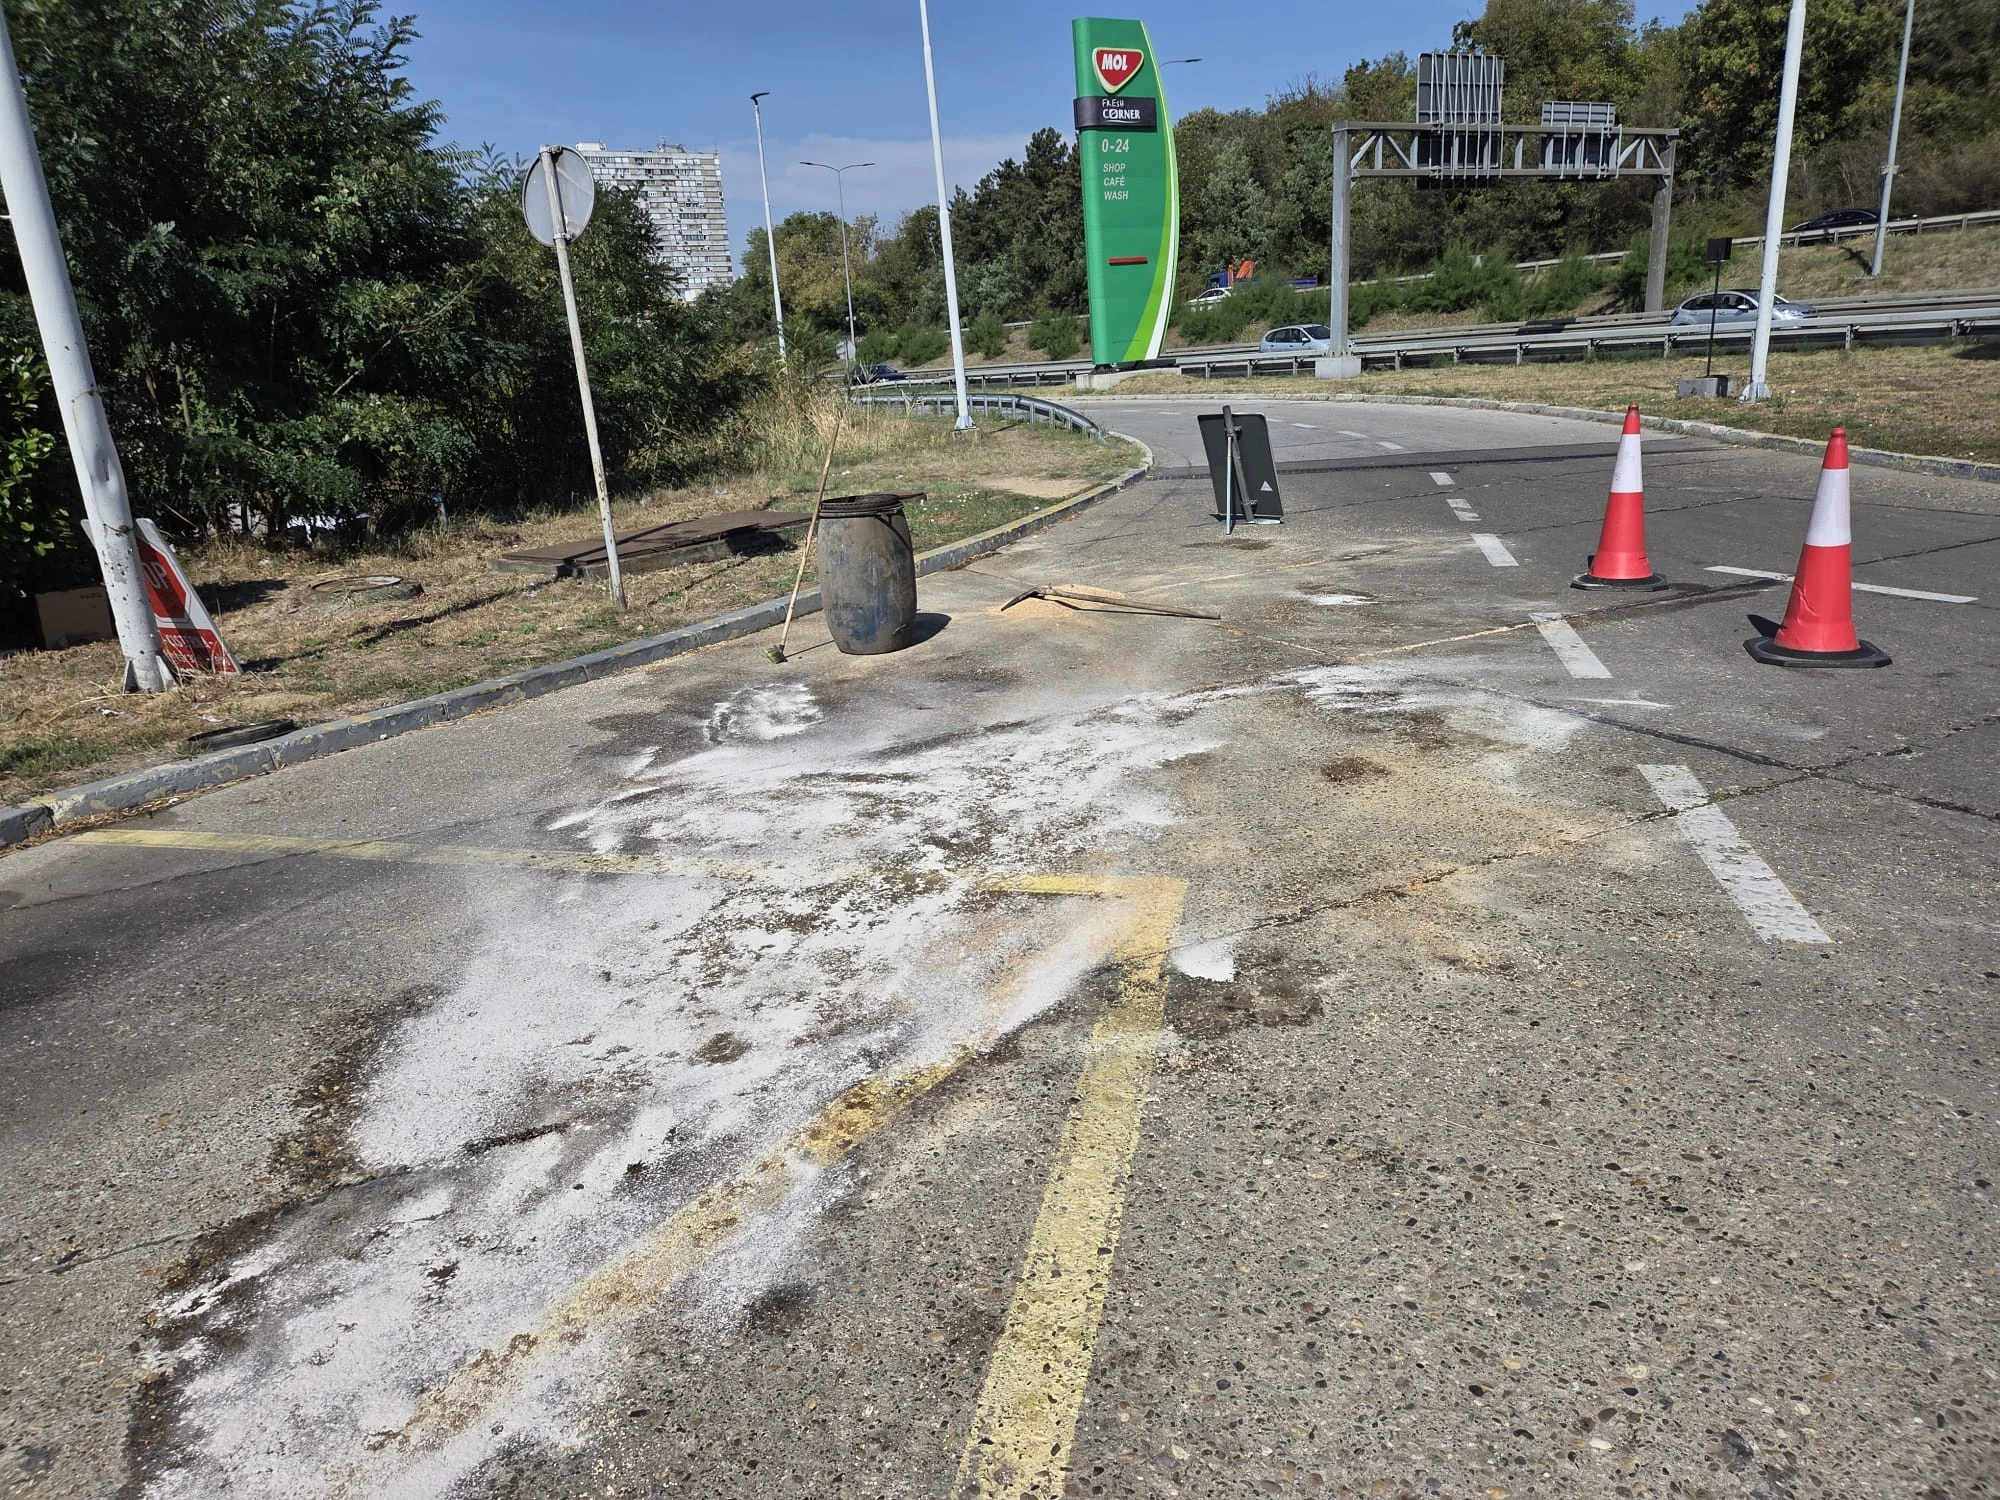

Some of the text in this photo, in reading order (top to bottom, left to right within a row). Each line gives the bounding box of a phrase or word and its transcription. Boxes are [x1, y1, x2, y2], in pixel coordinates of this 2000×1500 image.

[1101, 53, 1128, 71] MOL
[1103, 163, 1125, 172] SHOP
[1104, 191, 1129, 200] WASH
